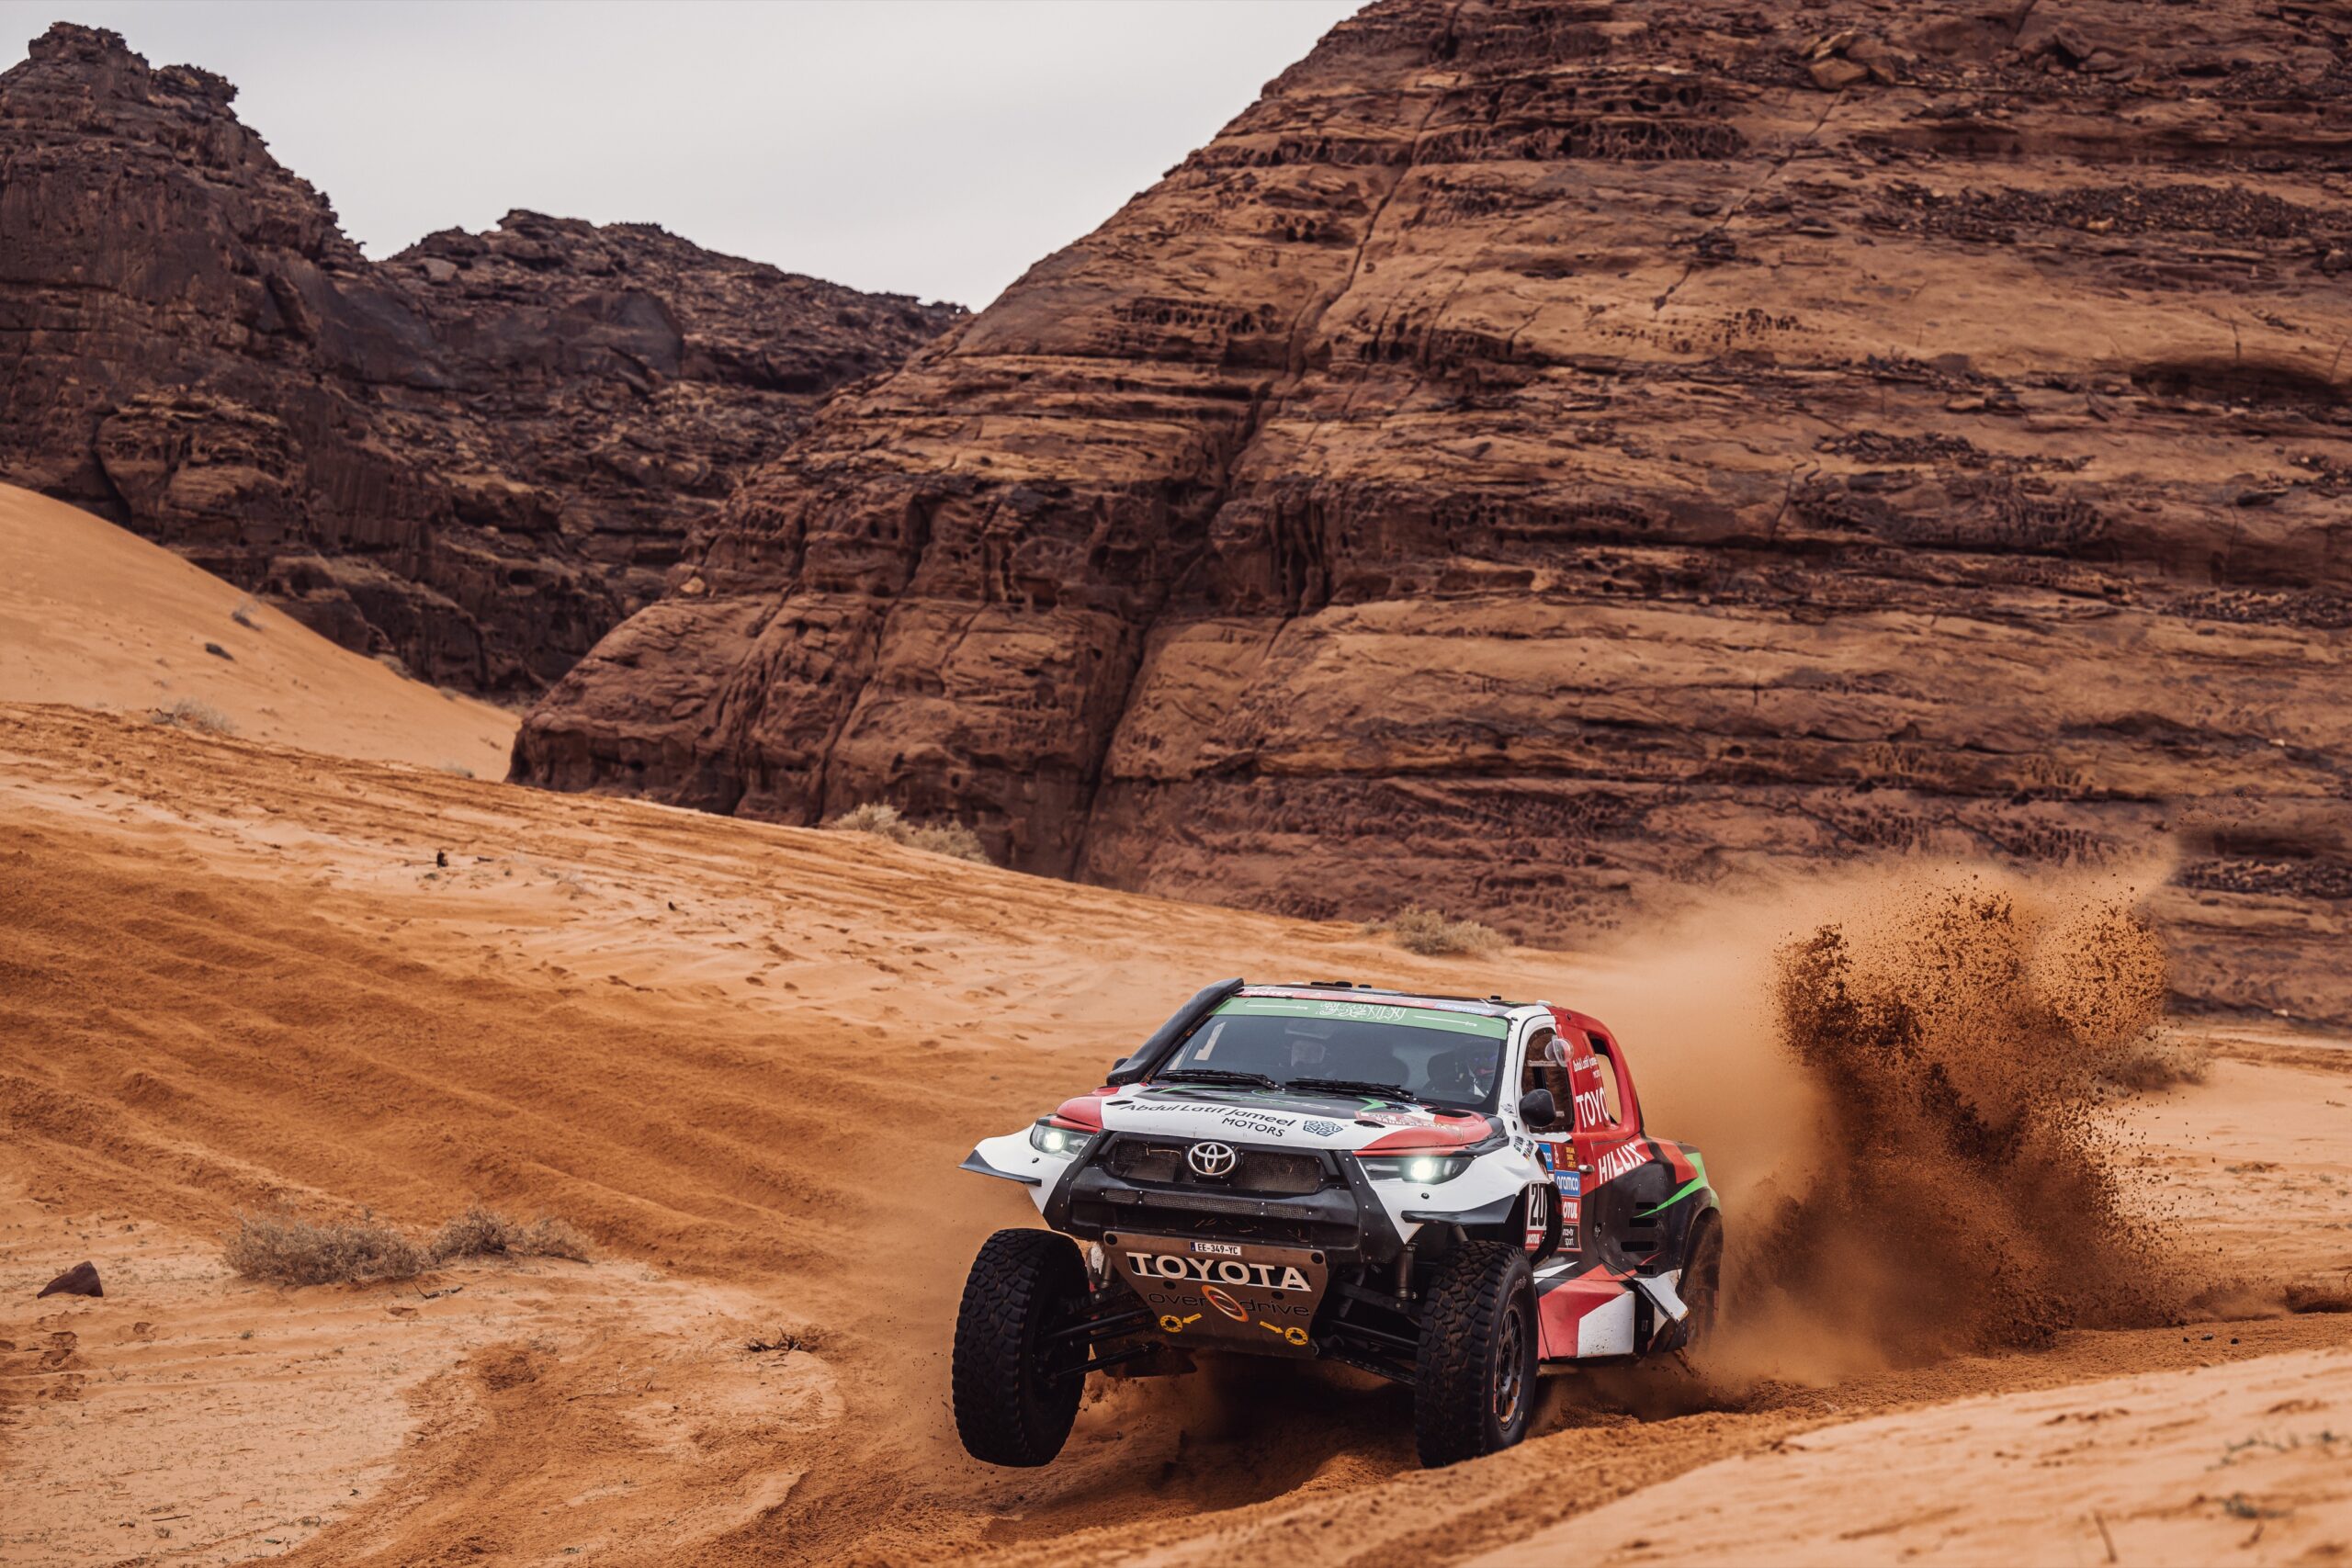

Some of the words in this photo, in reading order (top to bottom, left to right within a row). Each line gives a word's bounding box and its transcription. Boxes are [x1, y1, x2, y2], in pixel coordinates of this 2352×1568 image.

[1120, 1104, 1178, 1112] Abdul
[1180, 1104, 1228, 1114] Latif
[1226, 1108, 1297, 1127] Jameel
[1222, 1117, 1286, 1137] MOTORS
[1598, 1142, 1646, 1185] HILUX
[1557, 1176, 1579, 1191] aramco
[1563, 1201, 1577, 1219] OTUL
[1197, 1243, 1238, 1255] EE-349-YC
[1126, 1252, 1312, 1292] TOYOTA
[1148, 1293, 1205, 1307] over
[1239, 1298, 1310, 1316] drive
